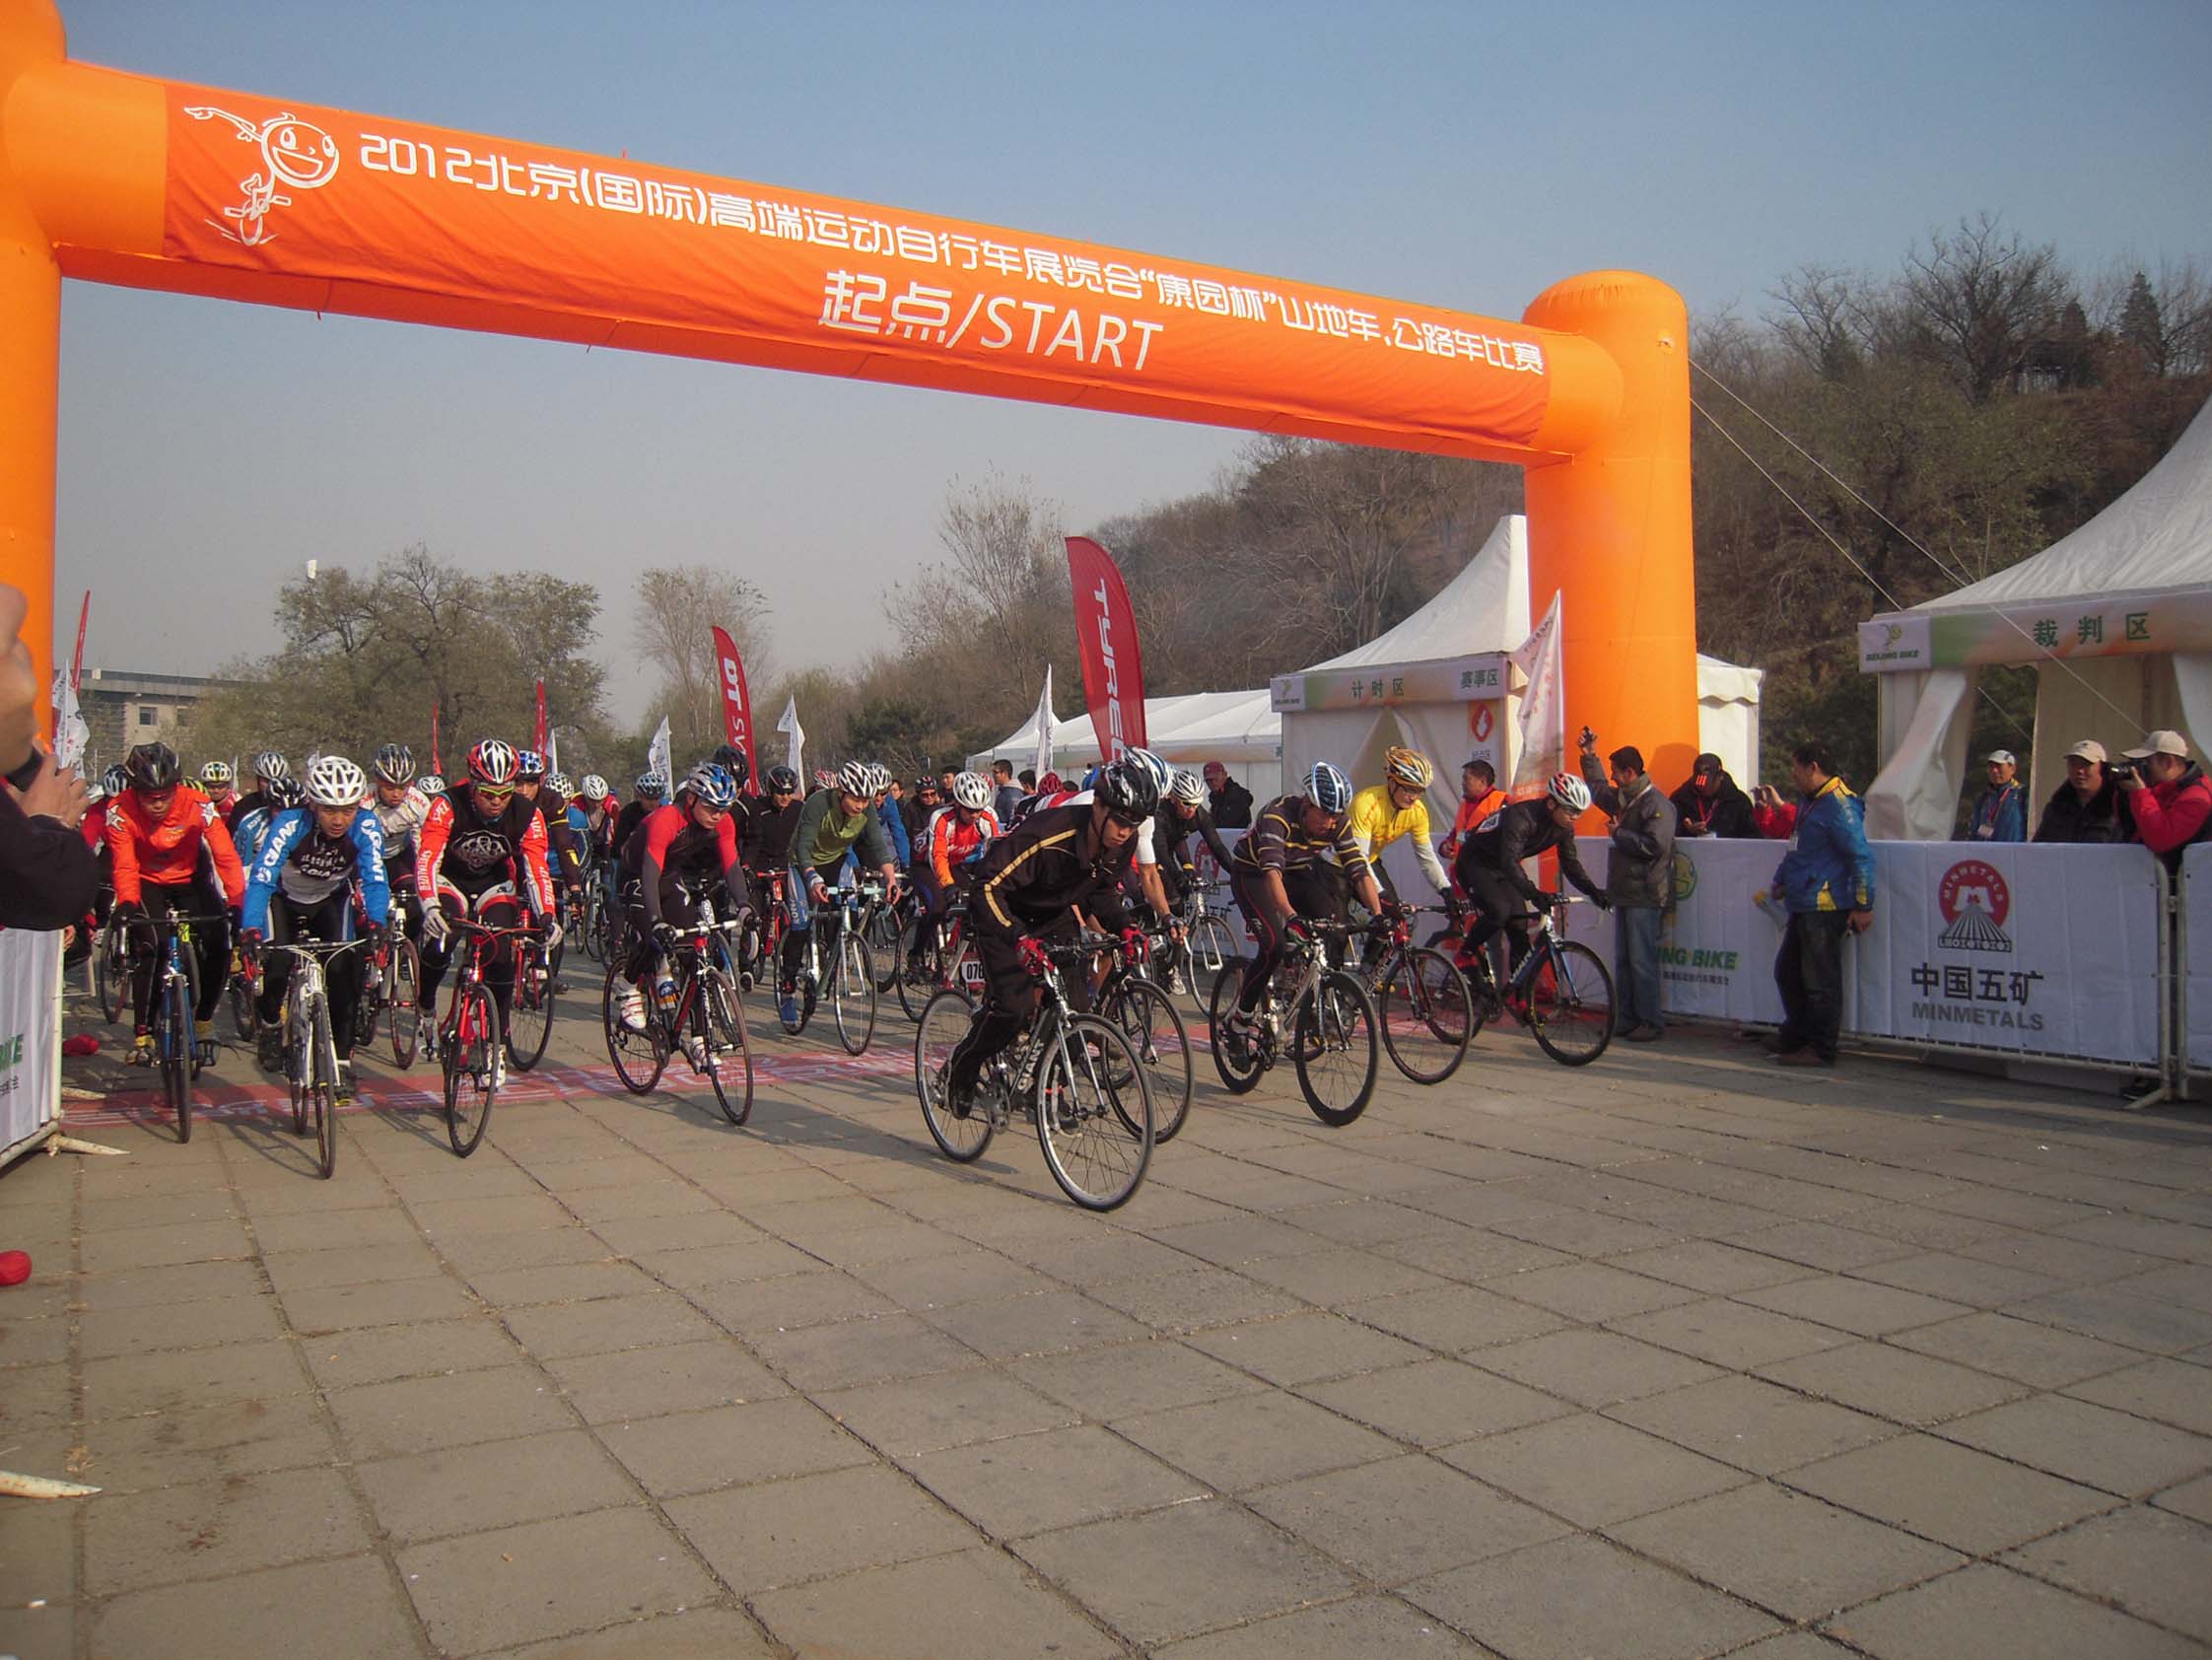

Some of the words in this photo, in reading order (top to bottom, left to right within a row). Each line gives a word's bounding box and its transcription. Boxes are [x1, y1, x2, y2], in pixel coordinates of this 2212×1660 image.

[818, 269, 1164, 371] 起点/START
[2033, 612, 2151, 647] 裁判区
[723, 657, 742, 712] DT
[1910, 961, 2043, 1005] 中国五矿
[1911, 1003, 2044, 1031] MINMETALS
